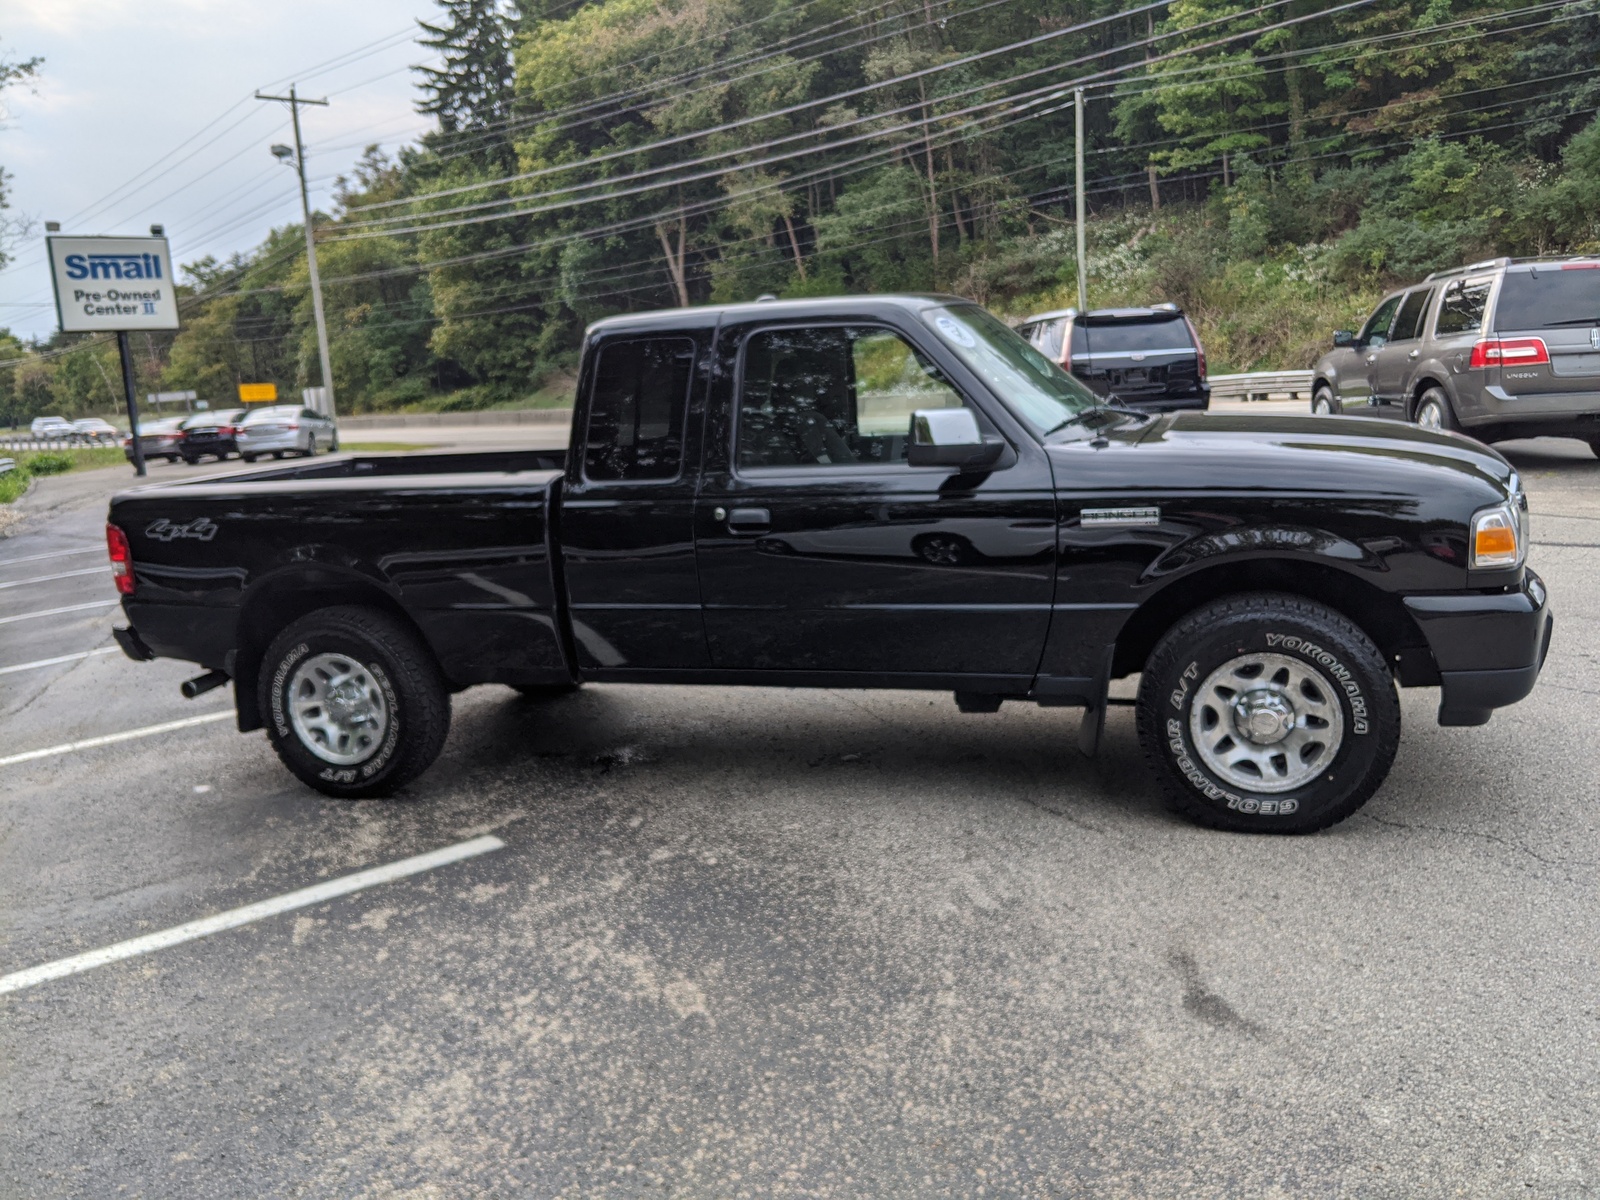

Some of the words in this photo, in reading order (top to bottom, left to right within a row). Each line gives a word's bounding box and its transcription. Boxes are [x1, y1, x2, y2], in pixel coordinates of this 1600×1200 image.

[65, 253, 162, 279] Smail
[74, 289, 161, 302] Pre-Owned
[84, 303, 138, 316] Center
[142, 302, 156, 315] II
[1171, 661, 1200, 710] A/T
[1265, 633, 1369, 735] YOKOHAMA
[1167, 718, 1300, 815] GEOLANDAR
